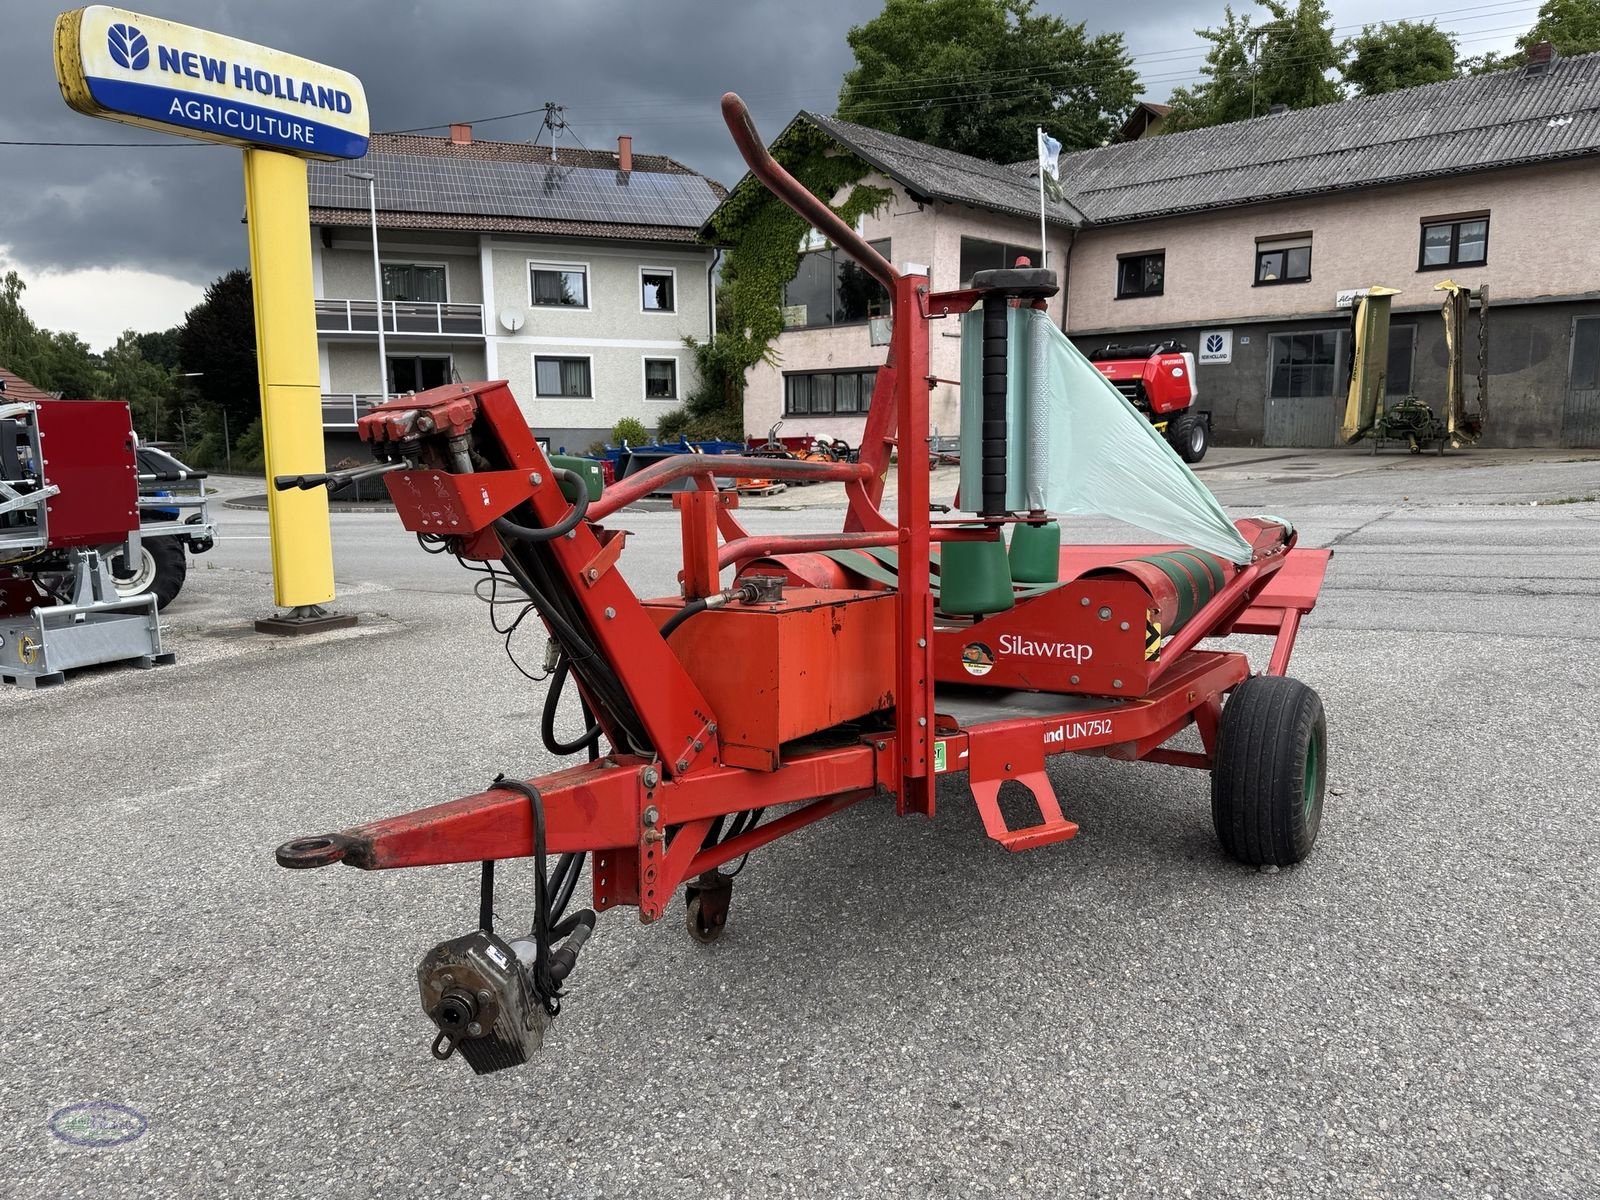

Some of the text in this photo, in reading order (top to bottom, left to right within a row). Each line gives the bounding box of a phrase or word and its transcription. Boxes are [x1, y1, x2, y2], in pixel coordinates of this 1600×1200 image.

[158, 45, 352, 114] NEW HOLLAND
[169, 97, 315, 144] AGRICULTURE
[999, 634, 1093, 664] Silawrap
[1066, 719, 1113, 739] UN7512
